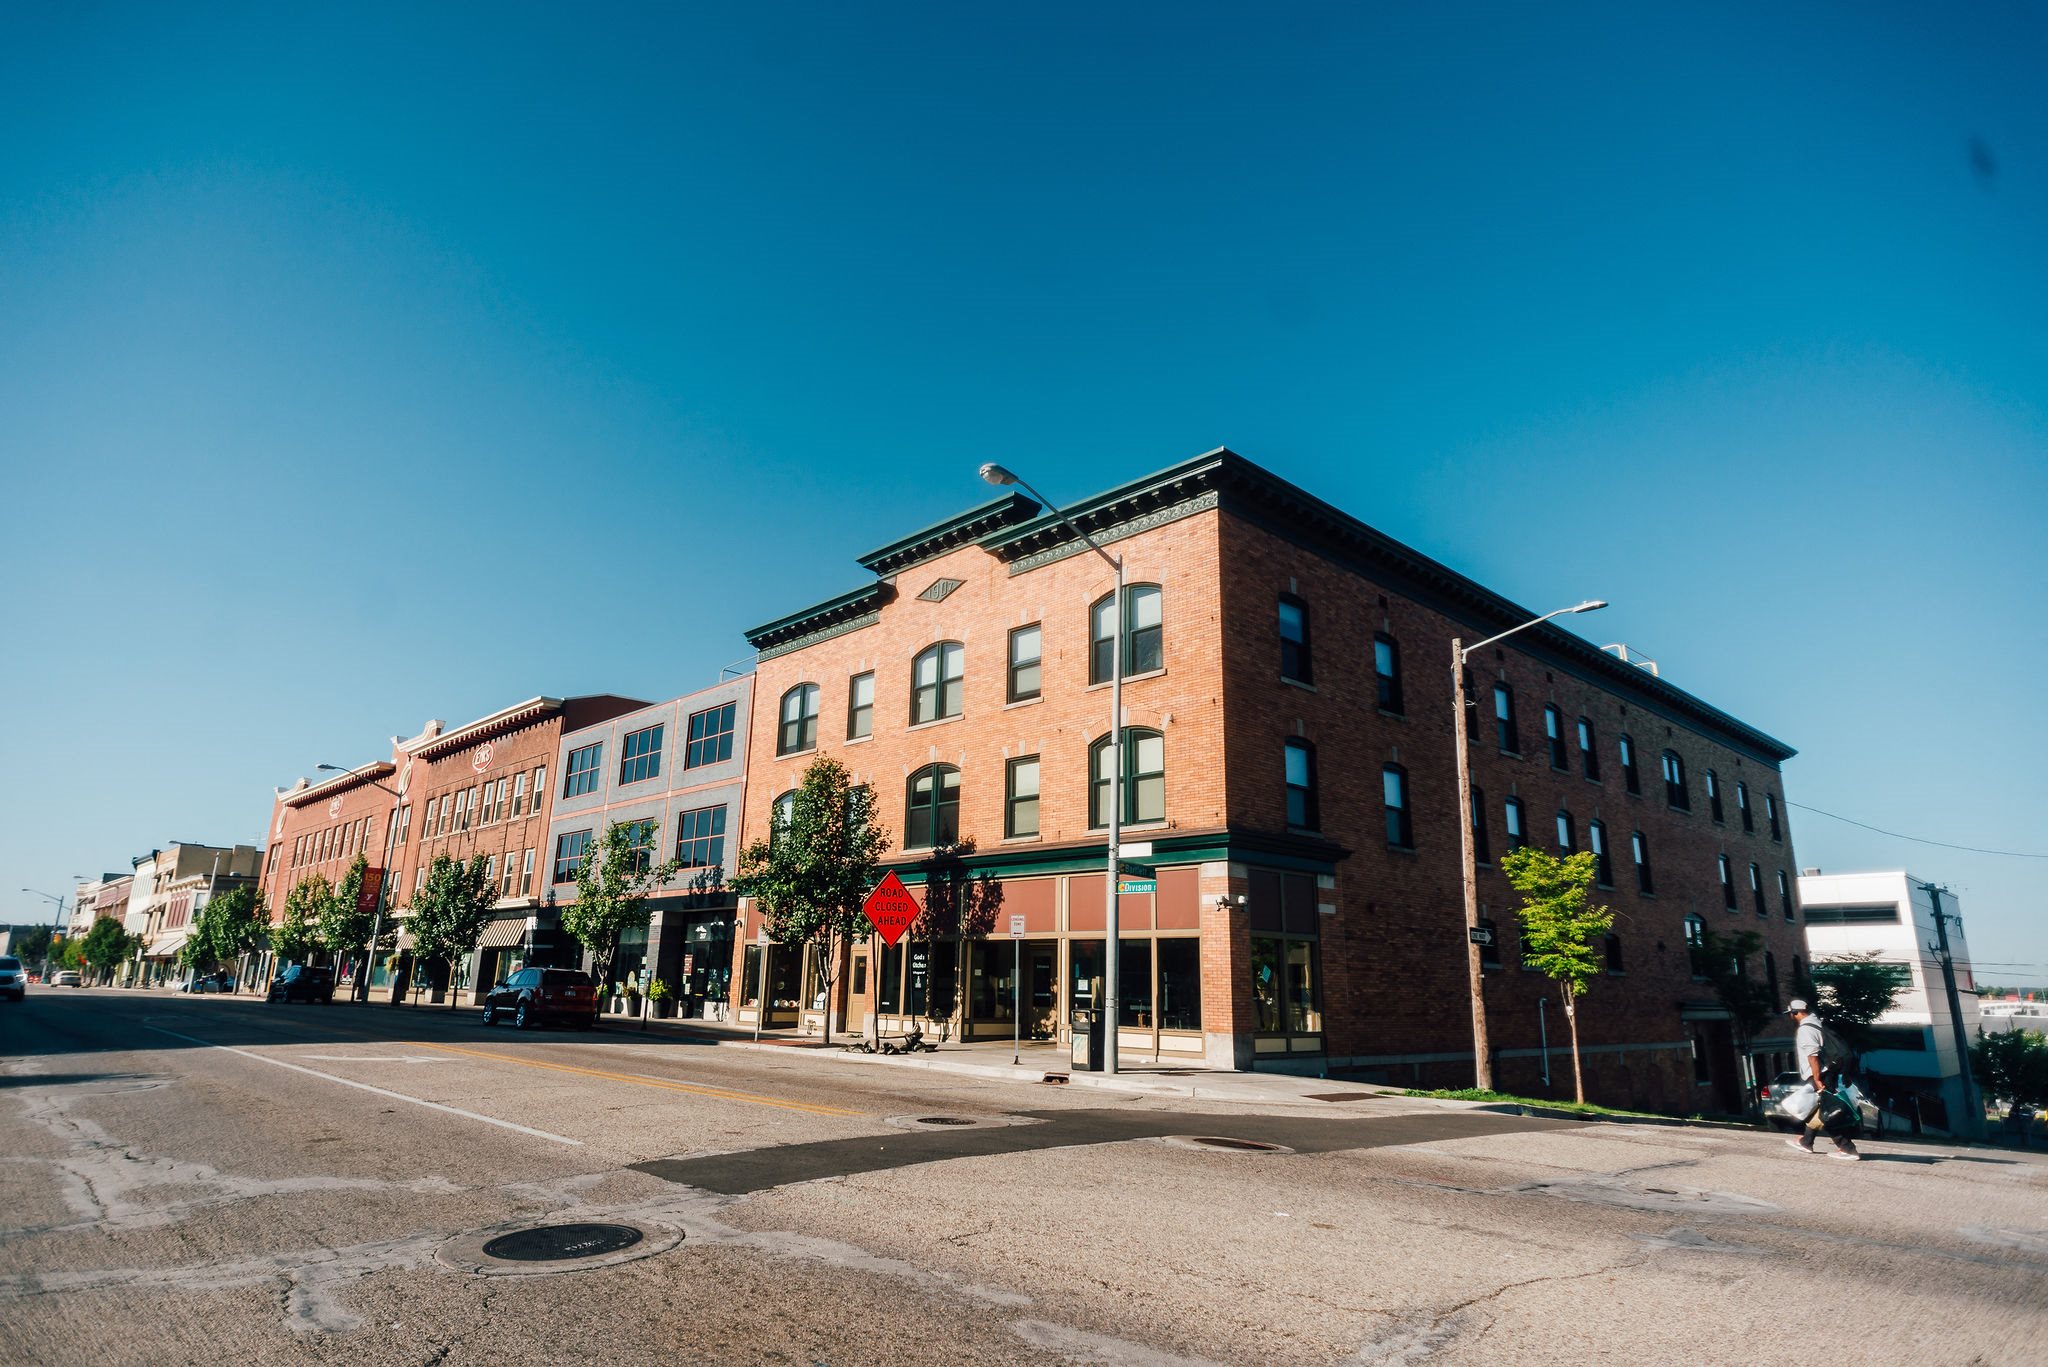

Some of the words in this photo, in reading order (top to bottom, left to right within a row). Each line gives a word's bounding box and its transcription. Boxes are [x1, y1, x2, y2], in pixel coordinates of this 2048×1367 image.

[365, 873, 381, 881] 150
[1124, 882, 1152, 892] Division
[880, 888, 904, 898] ROAD
[875, 901, 909, 912] CLOSED
[878, 916, 907, 926] AHEAD
